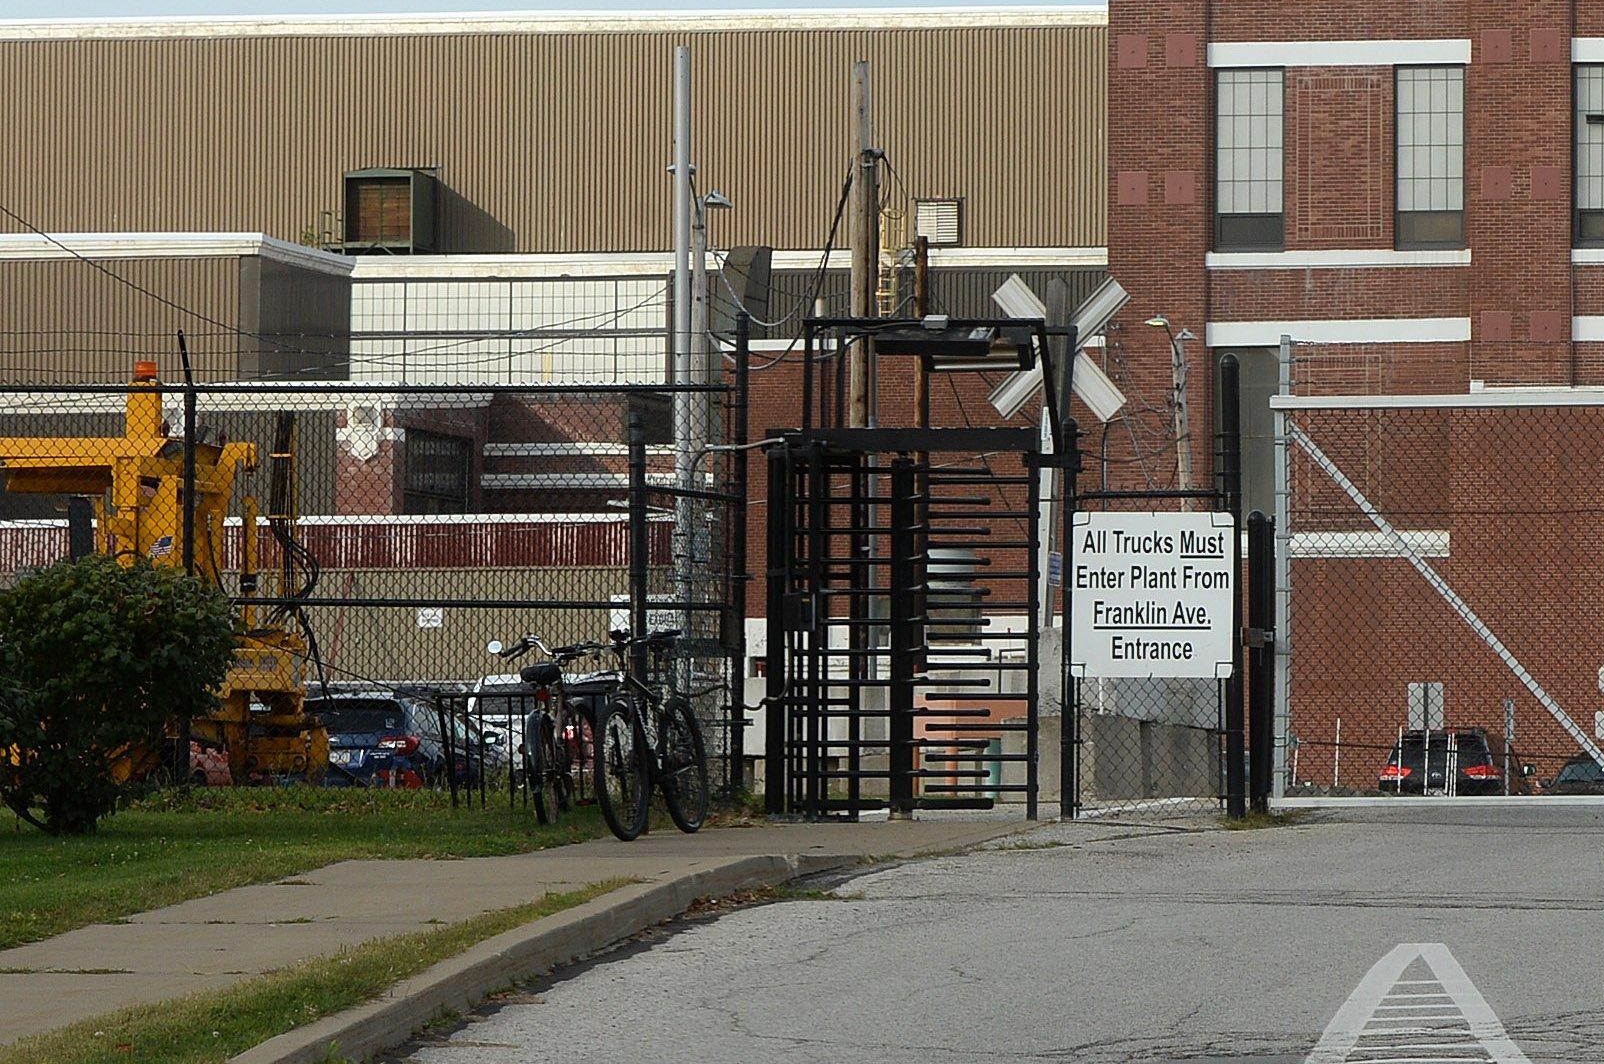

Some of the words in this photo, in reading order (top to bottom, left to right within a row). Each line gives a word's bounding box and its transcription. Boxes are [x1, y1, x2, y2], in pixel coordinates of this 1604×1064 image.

[1082, 530, 1107, 554] All
[1113, 530, 1174, 554] Trucks
[1180, 530, 1224, 554] Must
[1076, 566, 1125, 589] Enter
[1131, 566, 1177, 589] Plant
[1183, 566, 1229, 589] From
[1093, 600, 1167, 625] Franklin
[1172, 600, 1211, 625] Ave.
[1112, 636, 1193, 660] Entrance
